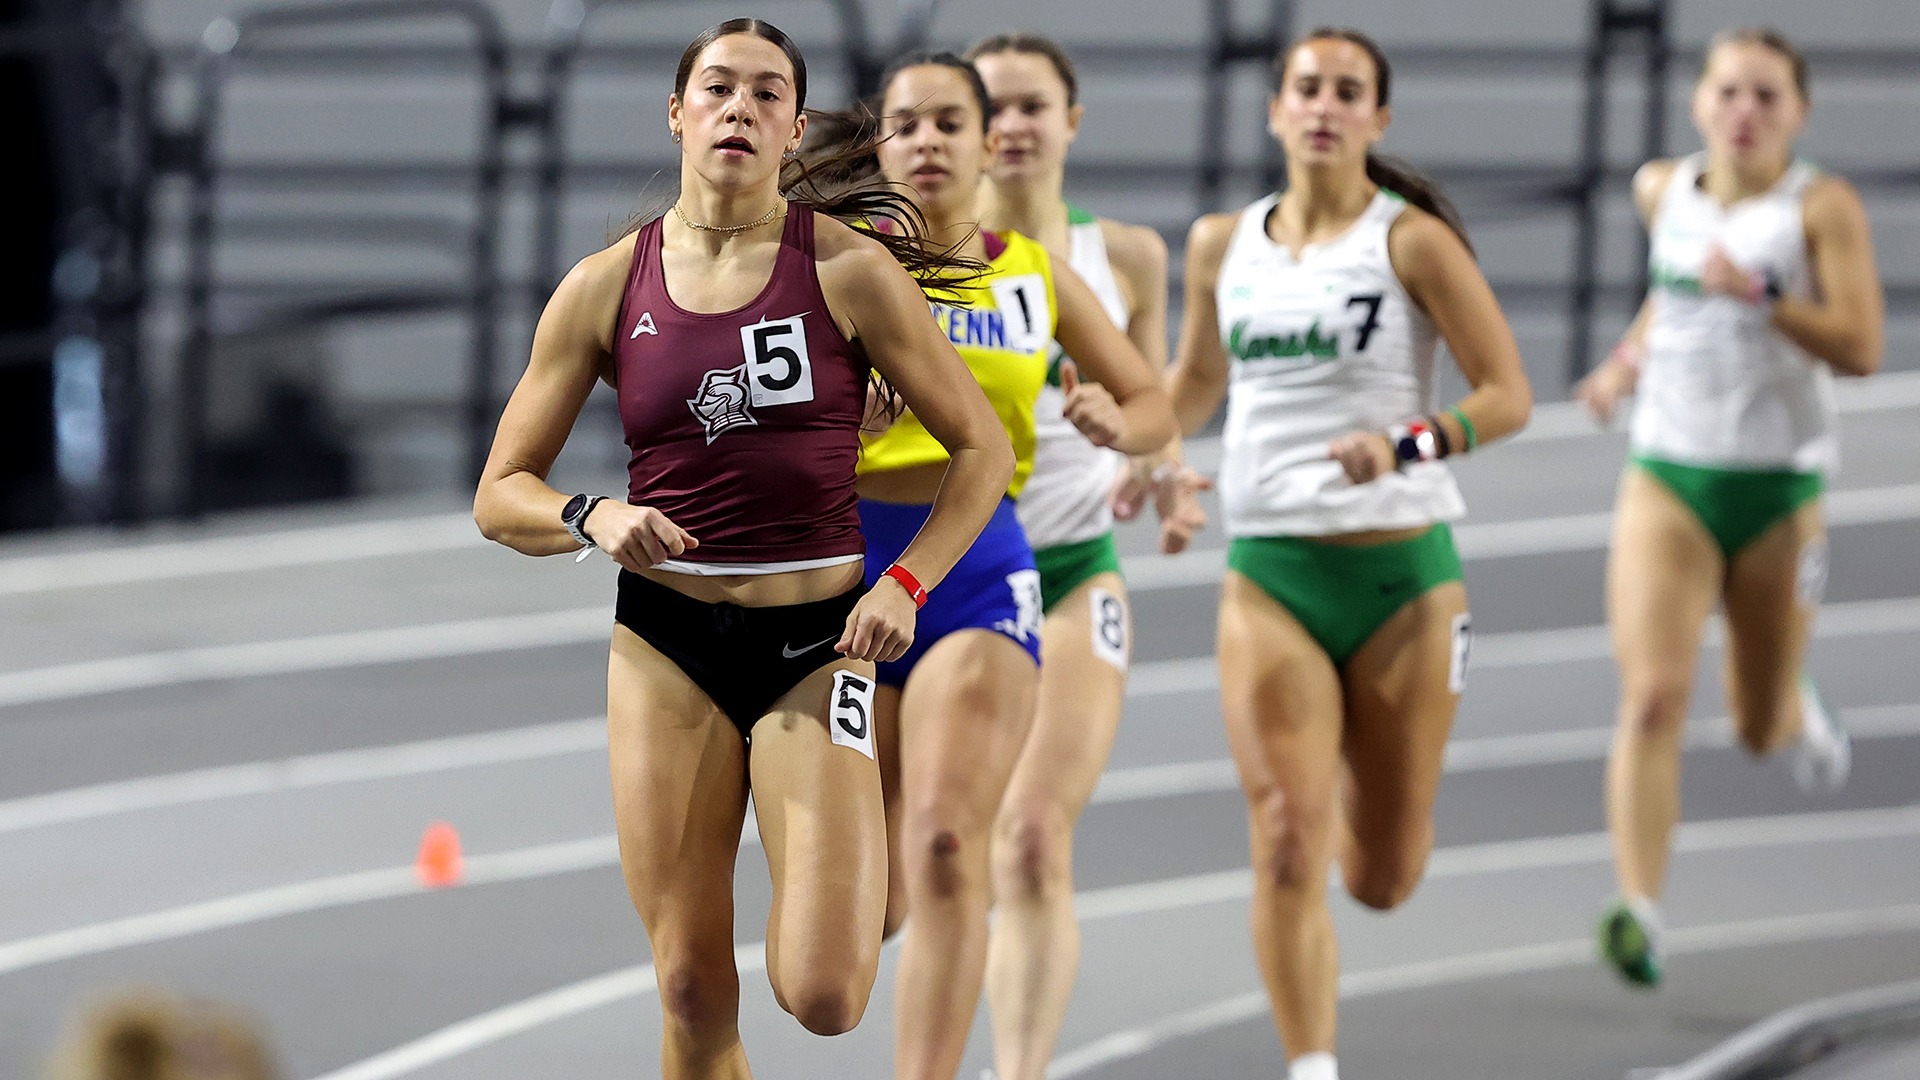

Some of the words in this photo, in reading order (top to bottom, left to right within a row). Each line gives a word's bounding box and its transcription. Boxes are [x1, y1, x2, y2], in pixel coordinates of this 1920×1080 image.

[1013, 285, 1033, 336] 1
[1346, 293, 1387, 352] 7
[753, 324, 802, 392] 5
[1101, 597, 1123, 652] 8
[836, 674, 867, 740] 5
